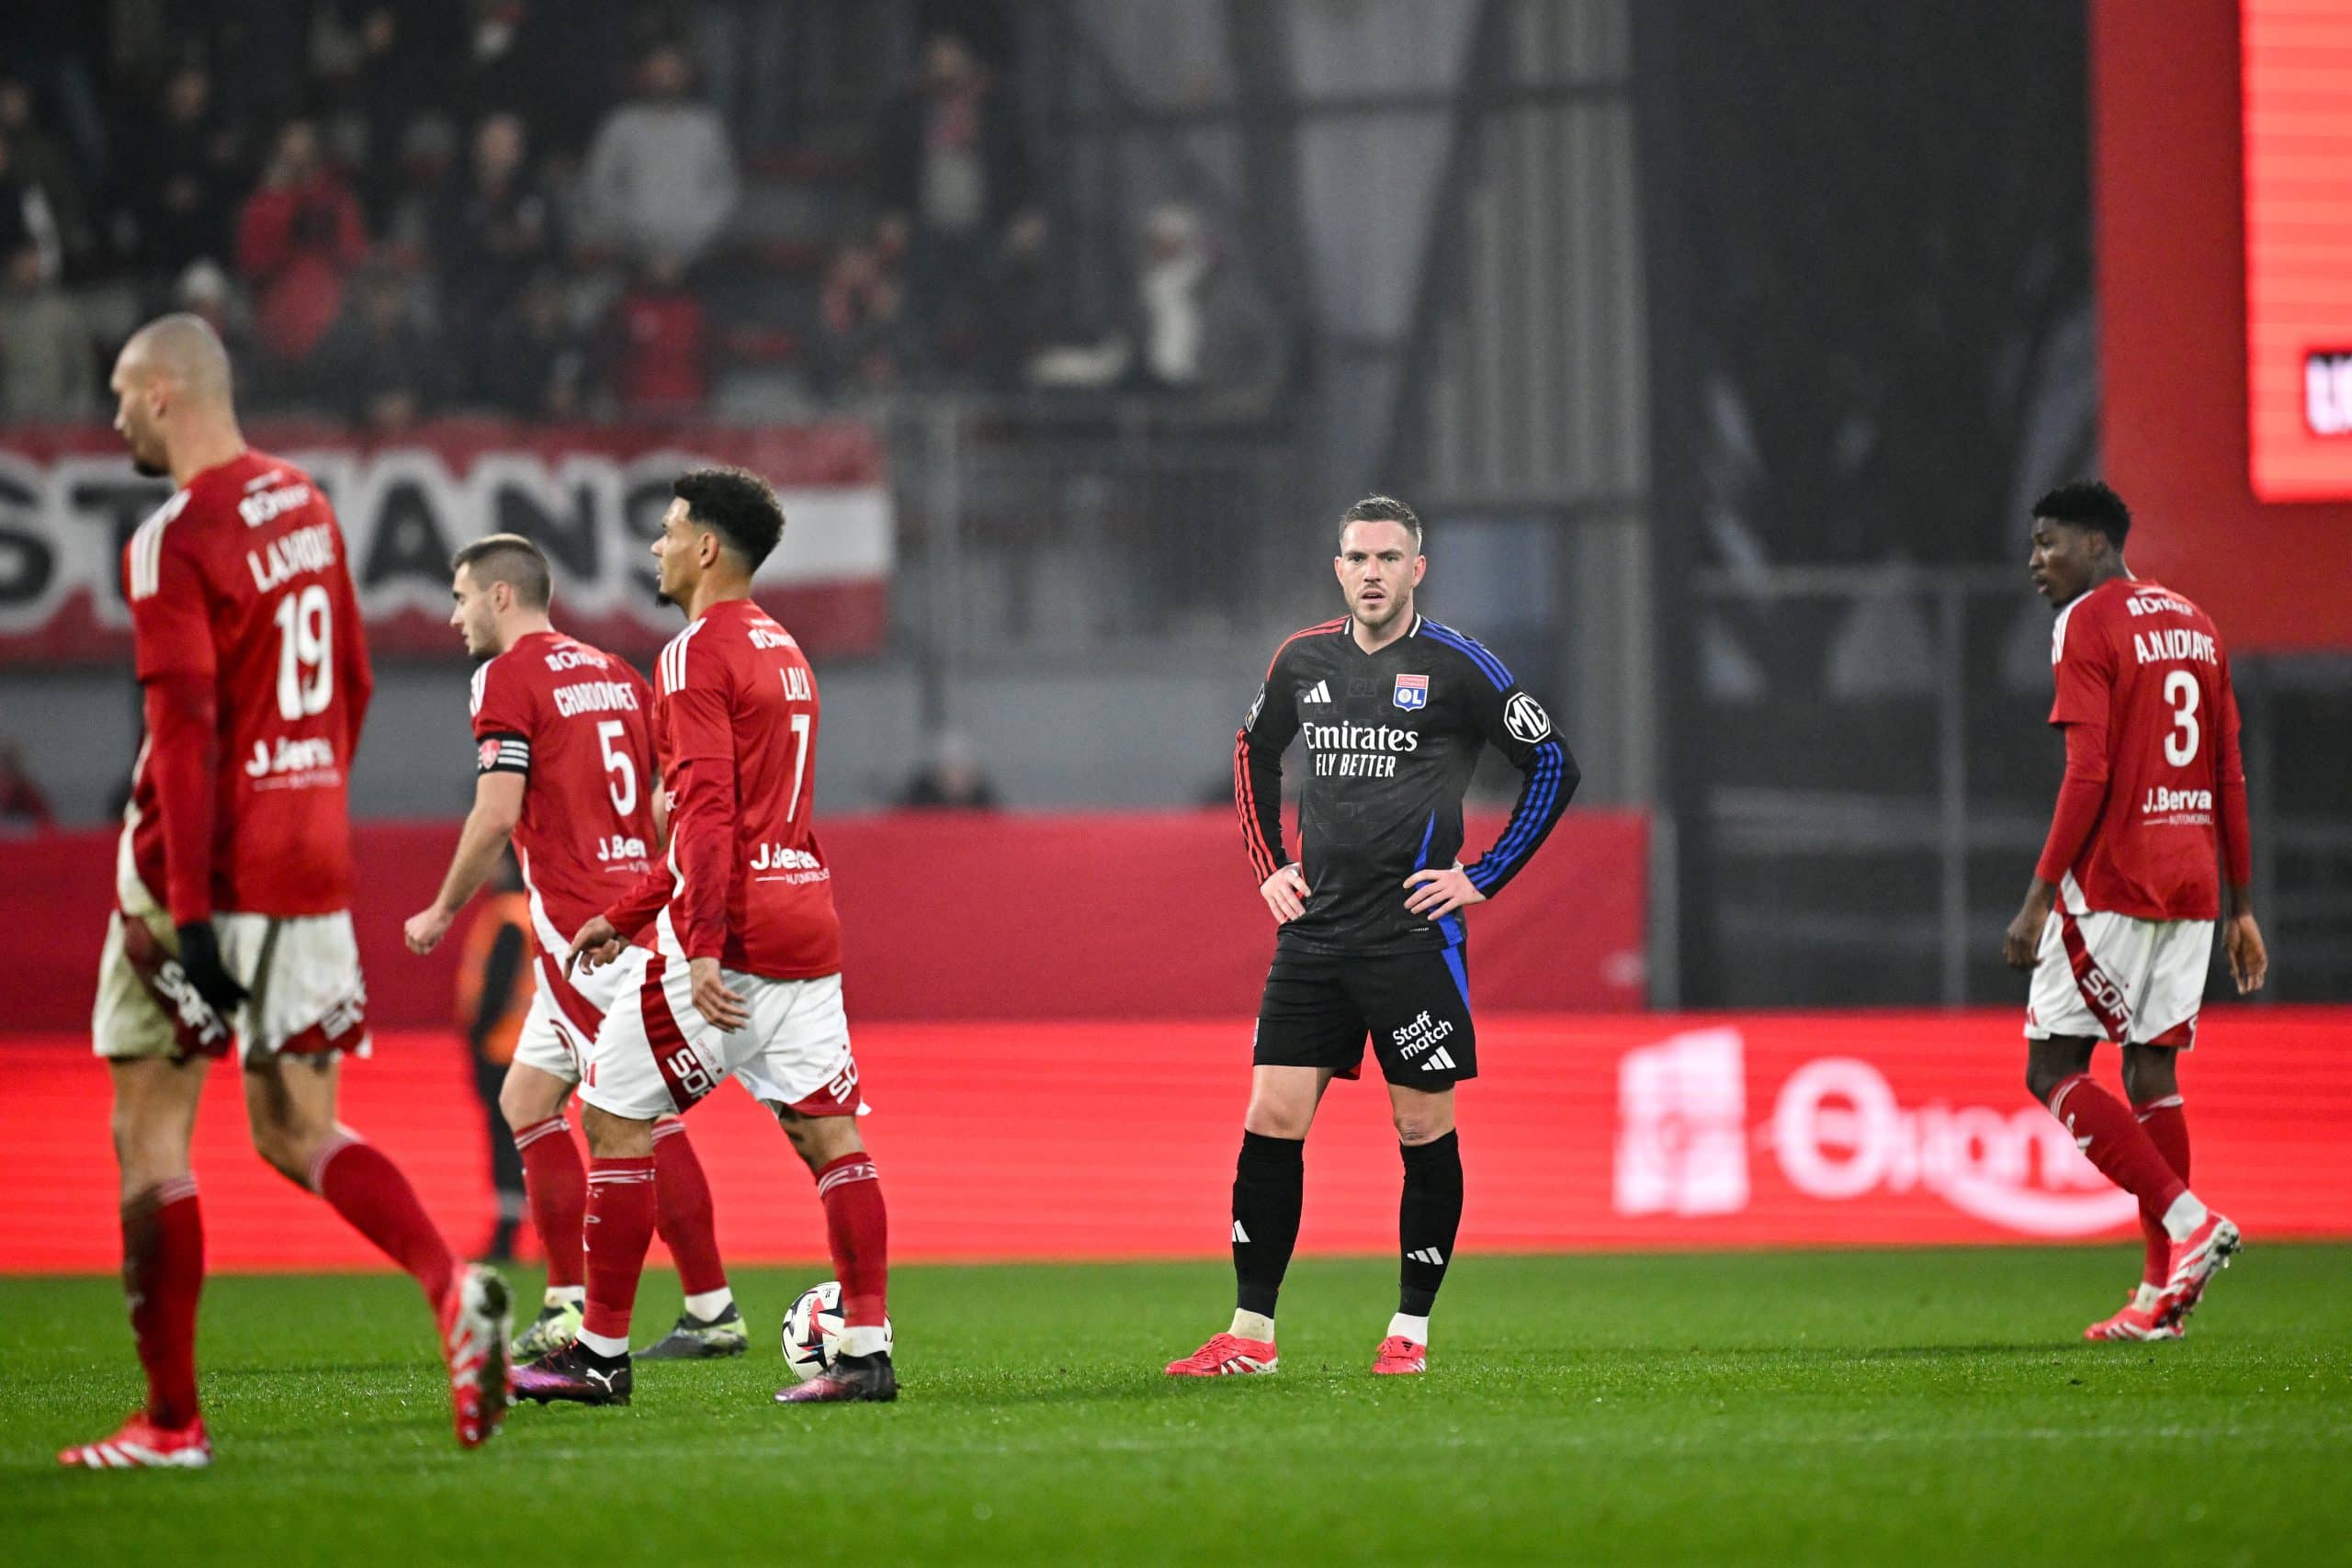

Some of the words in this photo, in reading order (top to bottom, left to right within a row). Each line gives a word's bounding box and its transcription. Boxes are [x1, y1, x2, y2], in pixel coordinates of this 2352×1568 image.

[274, 583, 334, 720] 19
[779, 667, 812, 702] LALA
[1397, 688, 1422, 705] OL
[1302, 719, 1419, 752] Emirates
[1509, 696, 1547, 739] MG
[2164, 670, 2199, 768] 3
[596, 719, 637, 817] 5
[786, 714, 810, 823] 7
[1316, 753, 1337, 777] FLY
[1339, 753, 1396, 778] BETTER
[1393, 1010, 1432, 1045] Staff
[1400, 1020, 1453, 1061] match
